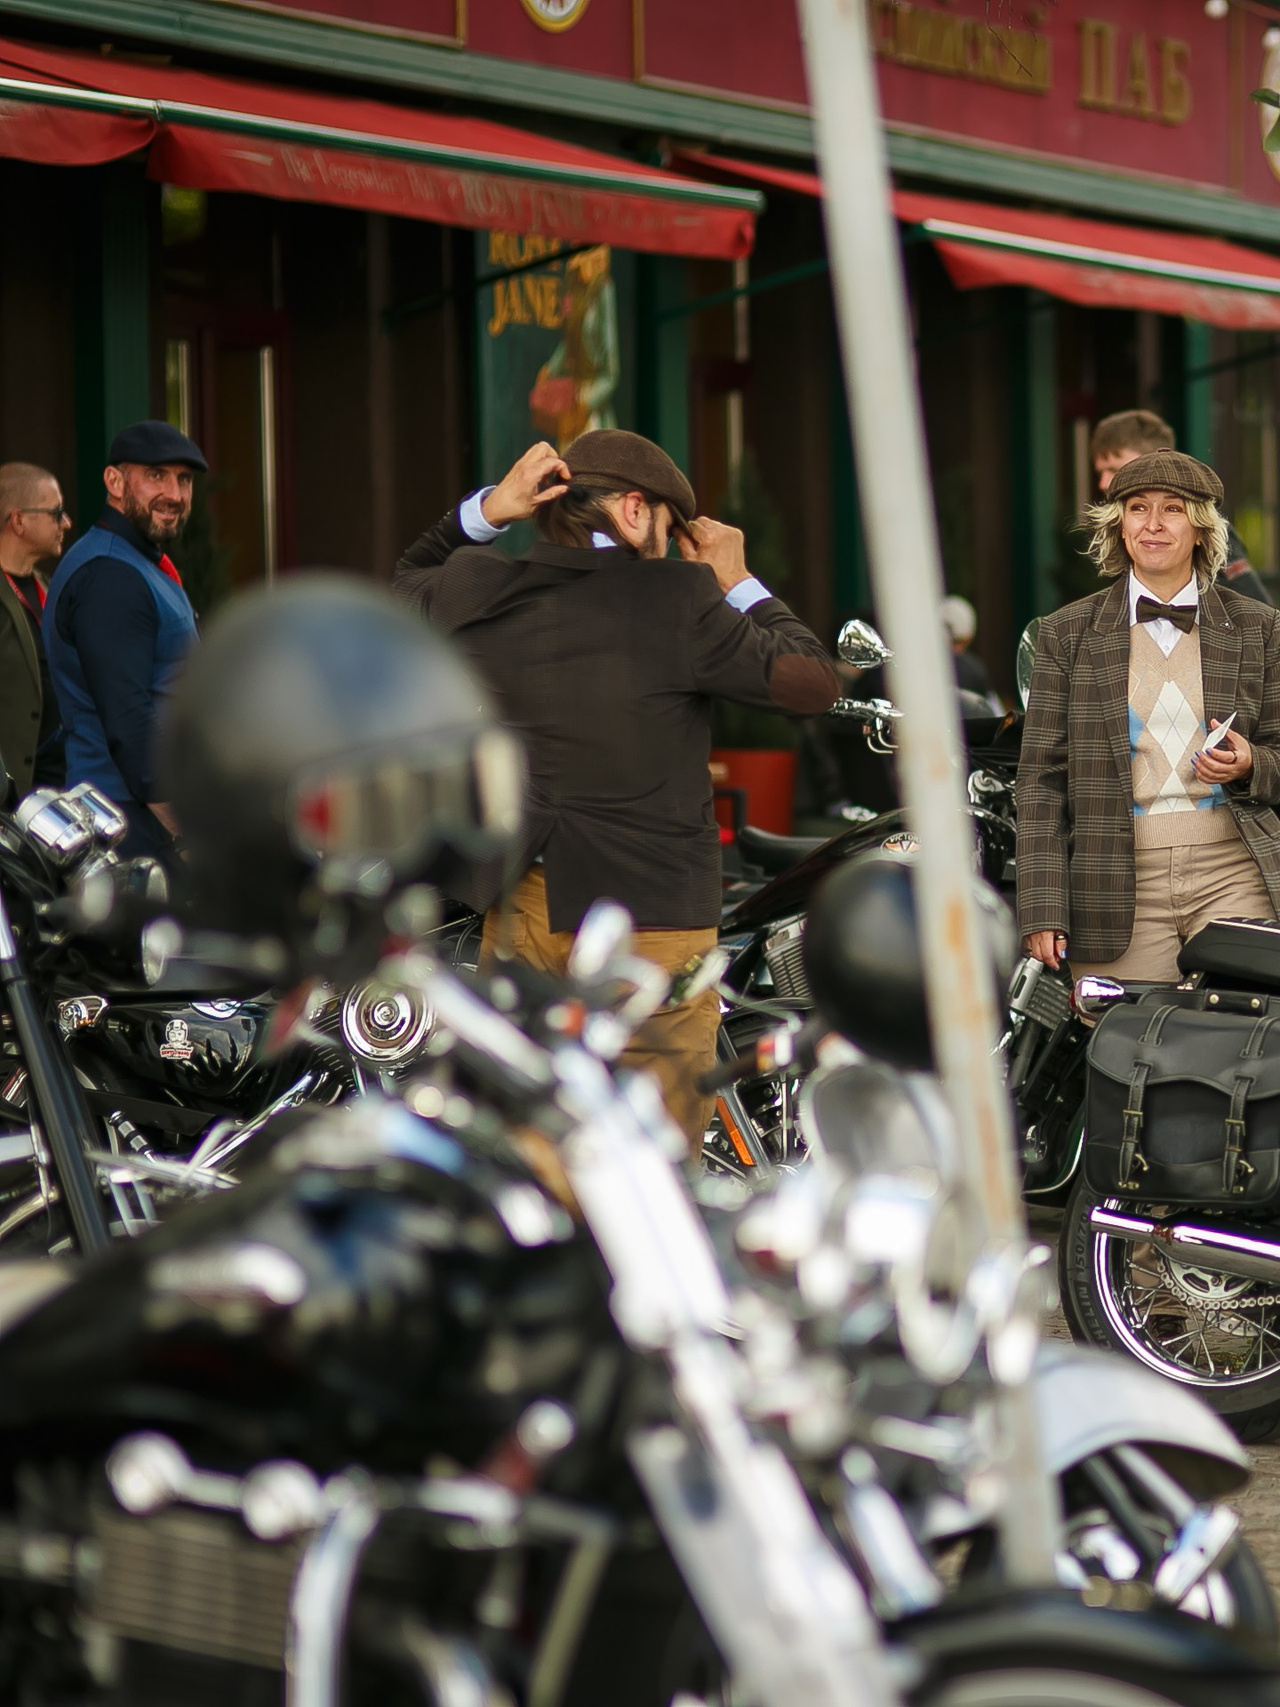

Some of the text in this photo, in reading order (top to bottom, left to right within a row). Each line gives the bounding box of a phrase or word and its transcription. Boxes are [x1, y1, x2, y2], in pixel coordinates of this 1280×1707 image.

[1075, 17, 1192, 127] ПАБ
[488, 273, 563, 337] JANE
[889, 833, 921, 844] VICTOR
[1075, 1214, 1089, 1273] 150/70
